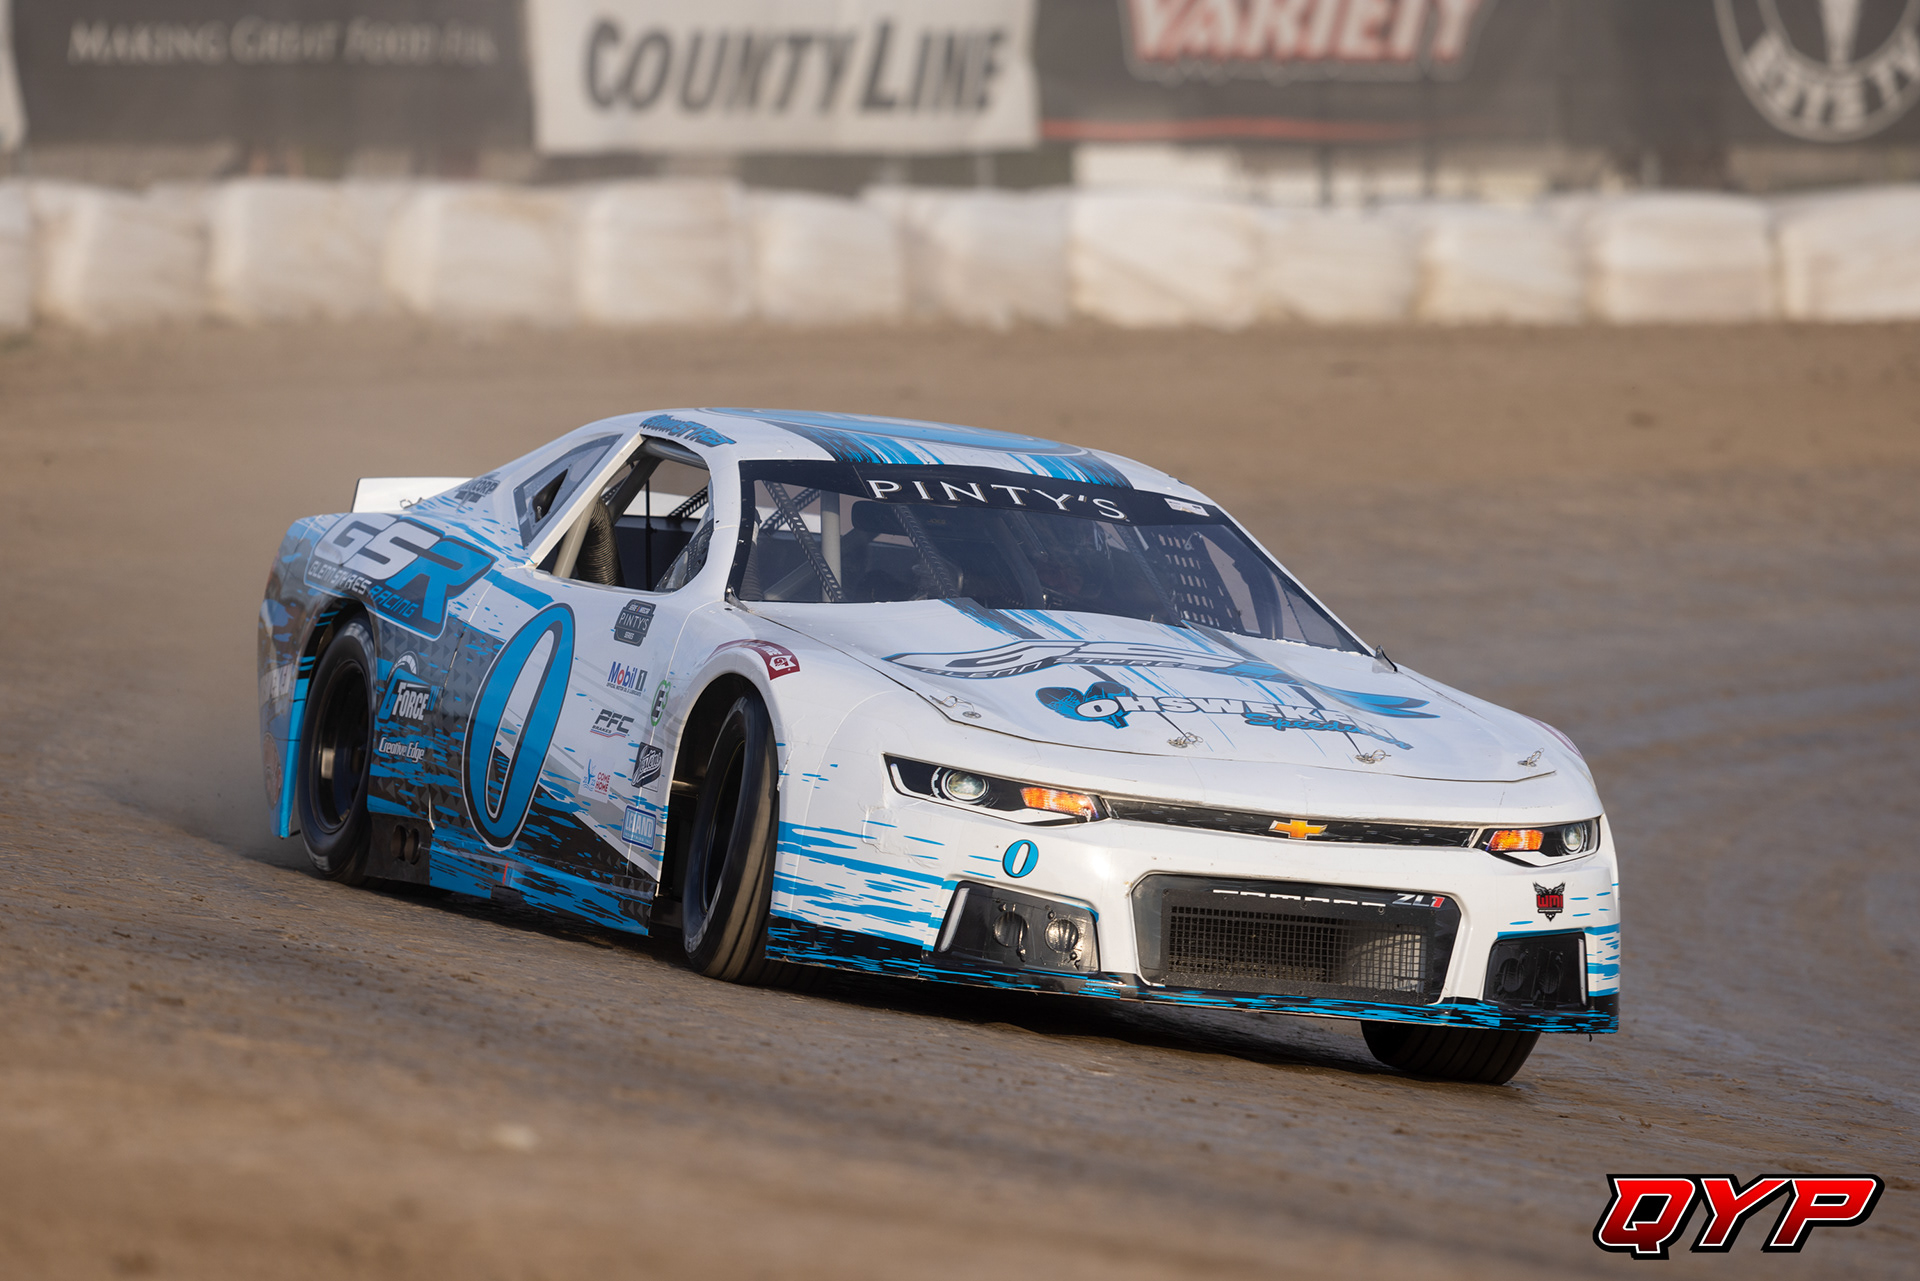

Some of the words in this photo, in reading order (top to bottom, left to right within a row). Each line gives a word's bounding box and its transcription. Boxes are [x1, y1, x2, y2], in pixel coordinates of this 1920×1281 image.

[866, 479, 1128, 521] PINTY'S
[313, 512, 494, 625] GSR
[368, 585, 419, 618] RACING
[619, 612, 650, 631] PINTY'S
[607, 661, 638, 689] Mobil
[592, 725, 612, 734] BRAKES
[594, 709, 634, 734] PFC
[379, 737, 407, 757] Creative
[406, 741, 425, 763] Edge
[595, 781, 609, 793] HOME
[597, 771, 611, 783] COME
[1002, 839, 1039, 878] 0
[1392, 893, 1445, 908] ZL1
